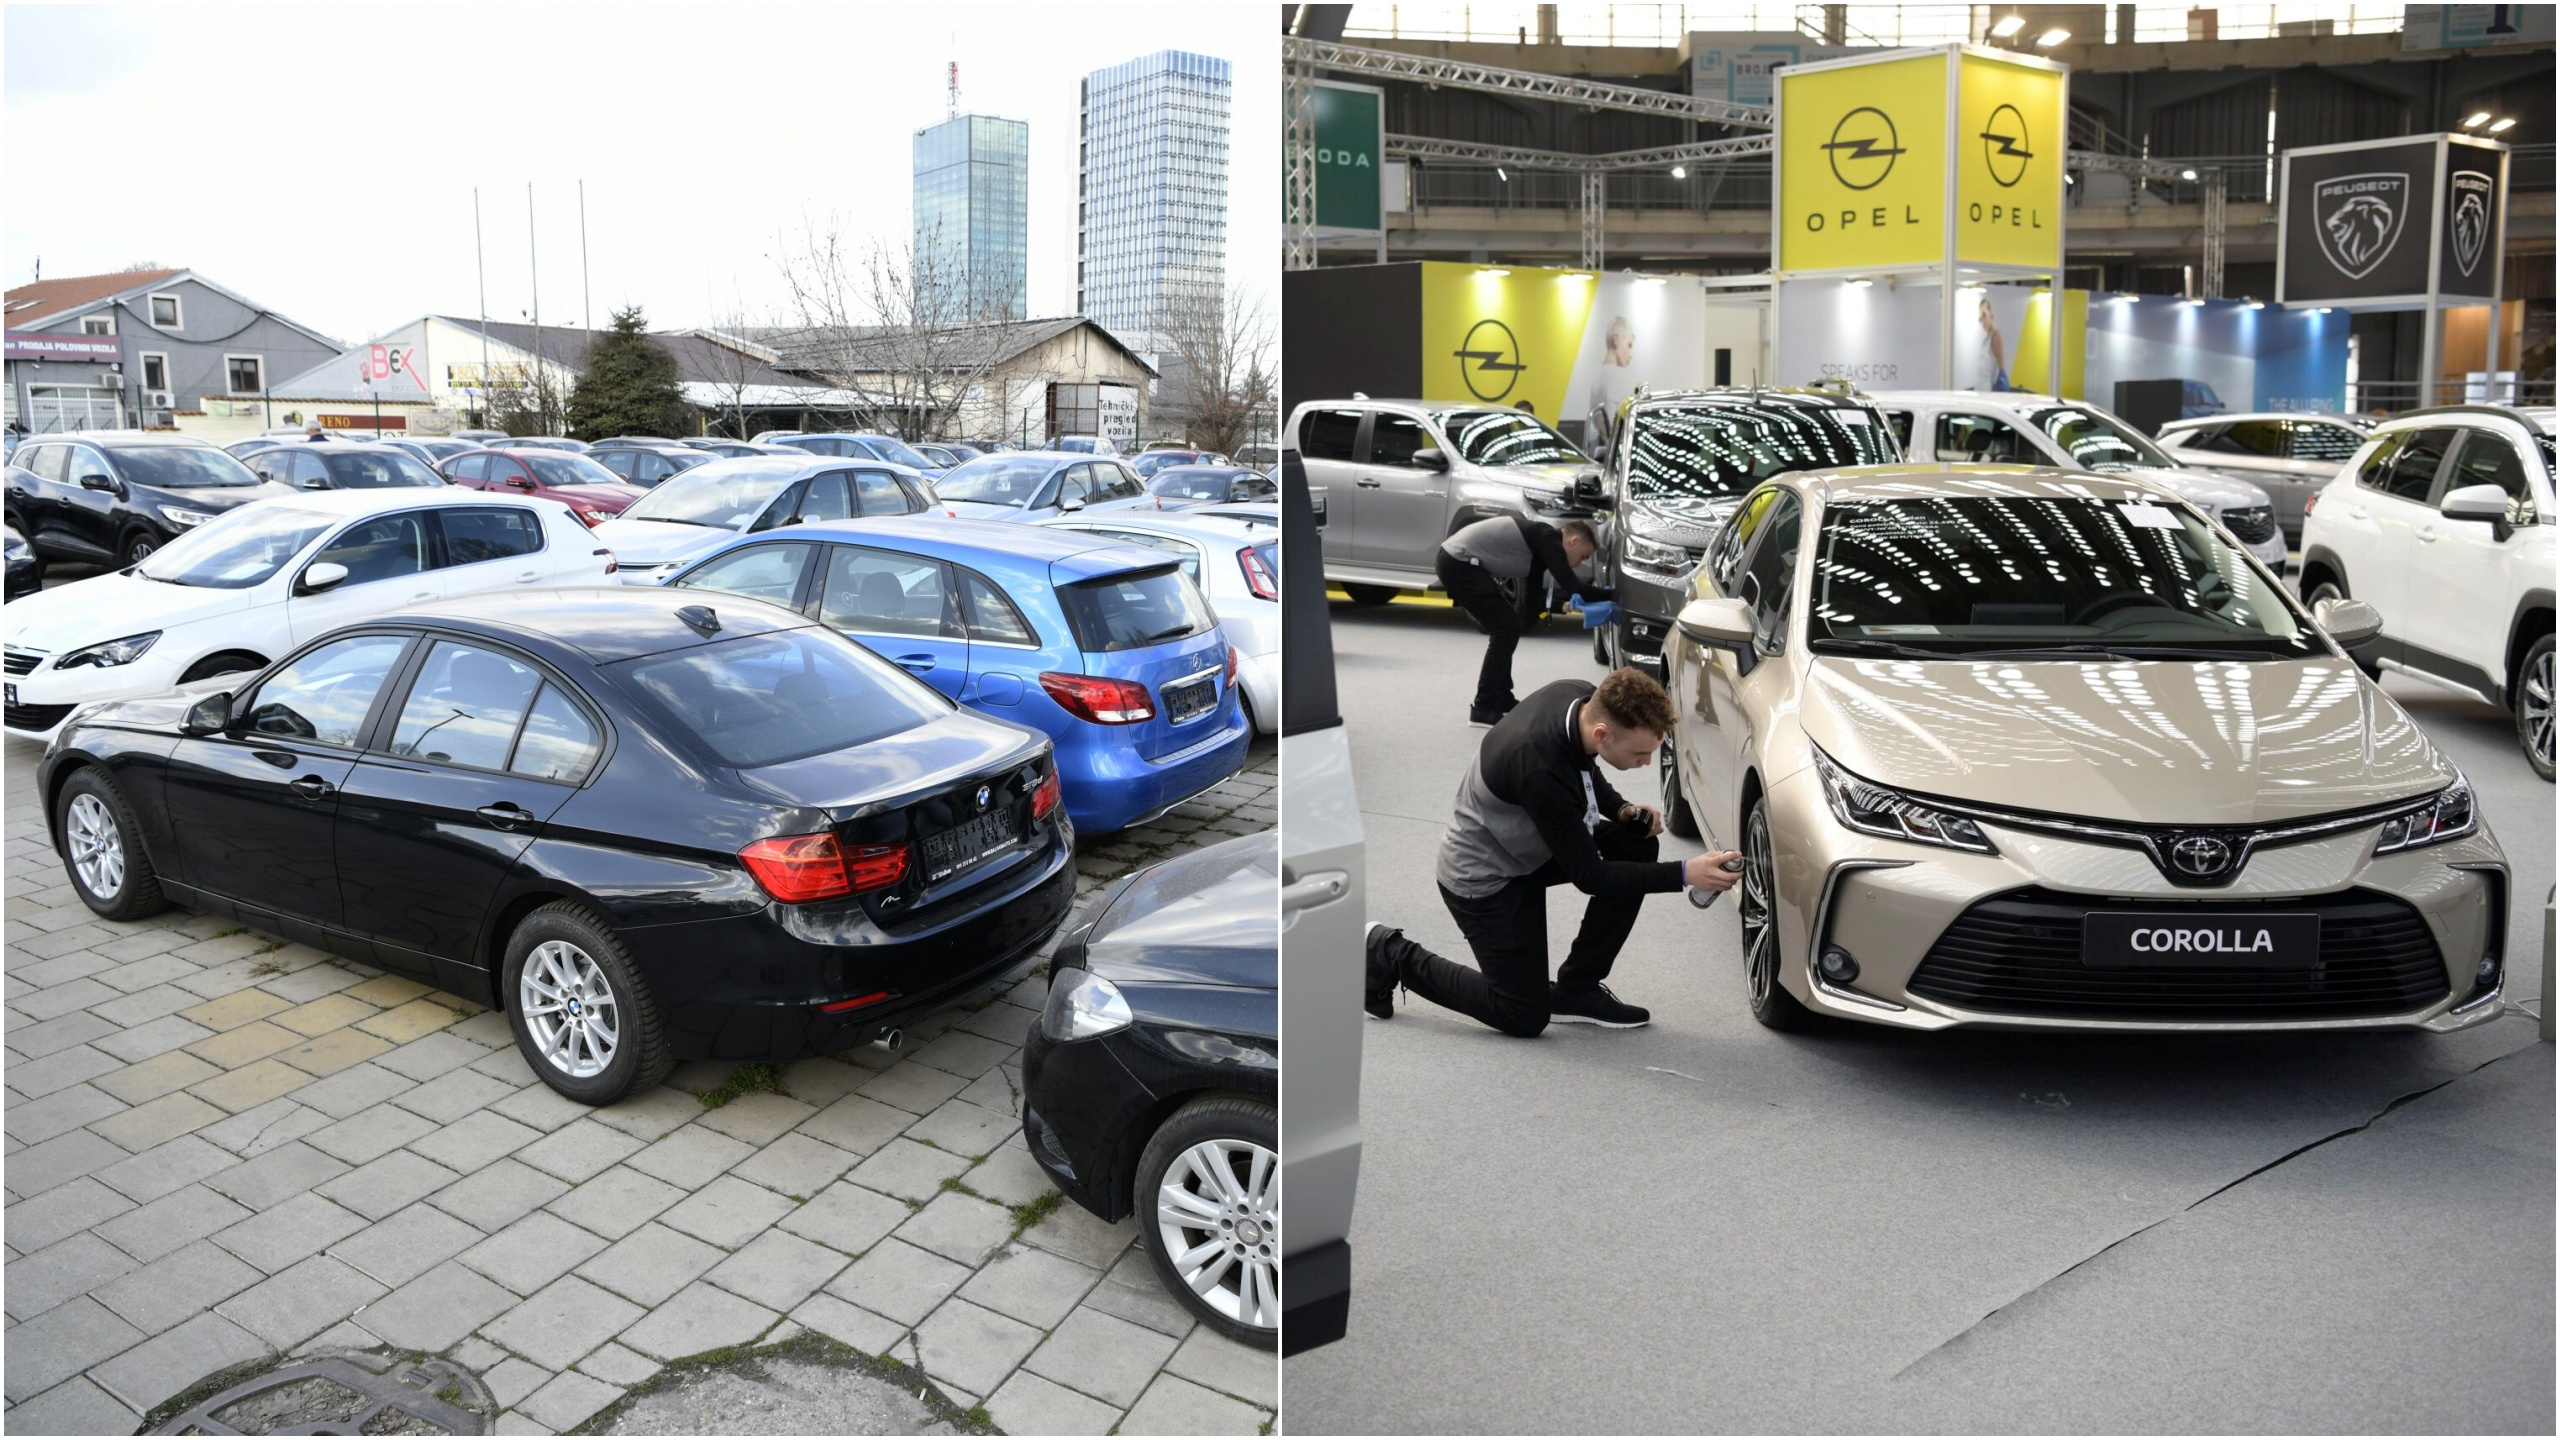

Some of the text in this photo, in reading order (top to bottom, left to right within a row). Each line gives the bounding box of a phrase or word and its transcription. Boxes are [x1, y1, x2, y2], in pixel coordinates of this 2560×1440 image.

[2322, 181, 2401, 197] PEUGEOT
[2456, 179, 2489, 192] PEUGEOT
[1806, 205, 1919, 232] OPEL
[1969, 202, 2042, 229] OPEL
[18, 341, 53, 351] PRODAJA
[54, 342, 91, 352] POLOVNIH
[91, 344, 117, 353] VOZILA
[1820, 363, 1899, 381] SPEAKS FOR
[318, 416, 351, 428] RENO
[1103, 413, 1137, 425] pregled
[1107, 425, 1132, 436] vozila
[2130, 928, 2274, 952] COROLLA
